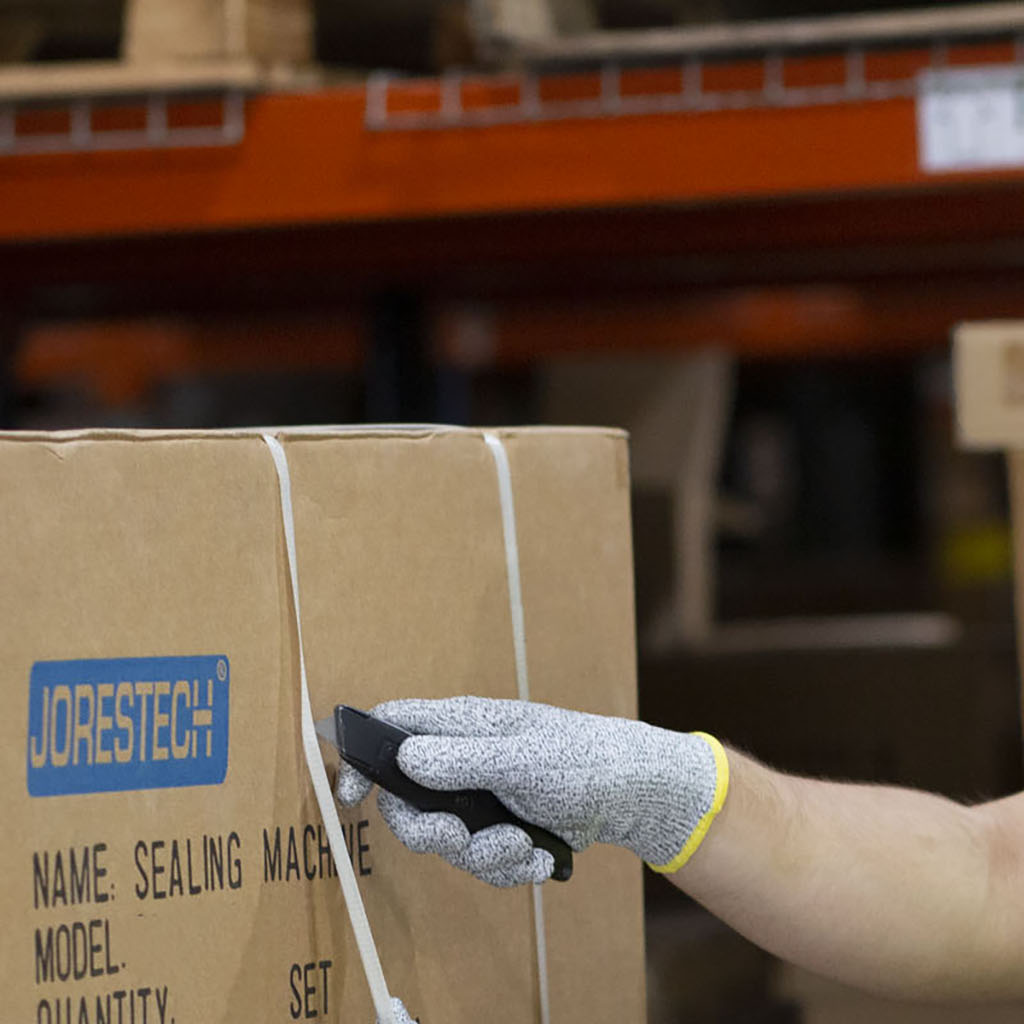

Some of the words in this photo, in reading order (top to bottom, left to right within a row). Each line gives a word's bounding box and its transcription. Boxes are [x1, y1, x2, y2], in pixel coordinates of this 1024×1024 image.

[31, 679, 213, 769] JORESTECH
[33, 843, 116, 910] NAME:
[134, 831, 243, 901] SEALING
[263, 819, 373, 882] MACHNE
[289, 960, 332, 1020] SET
